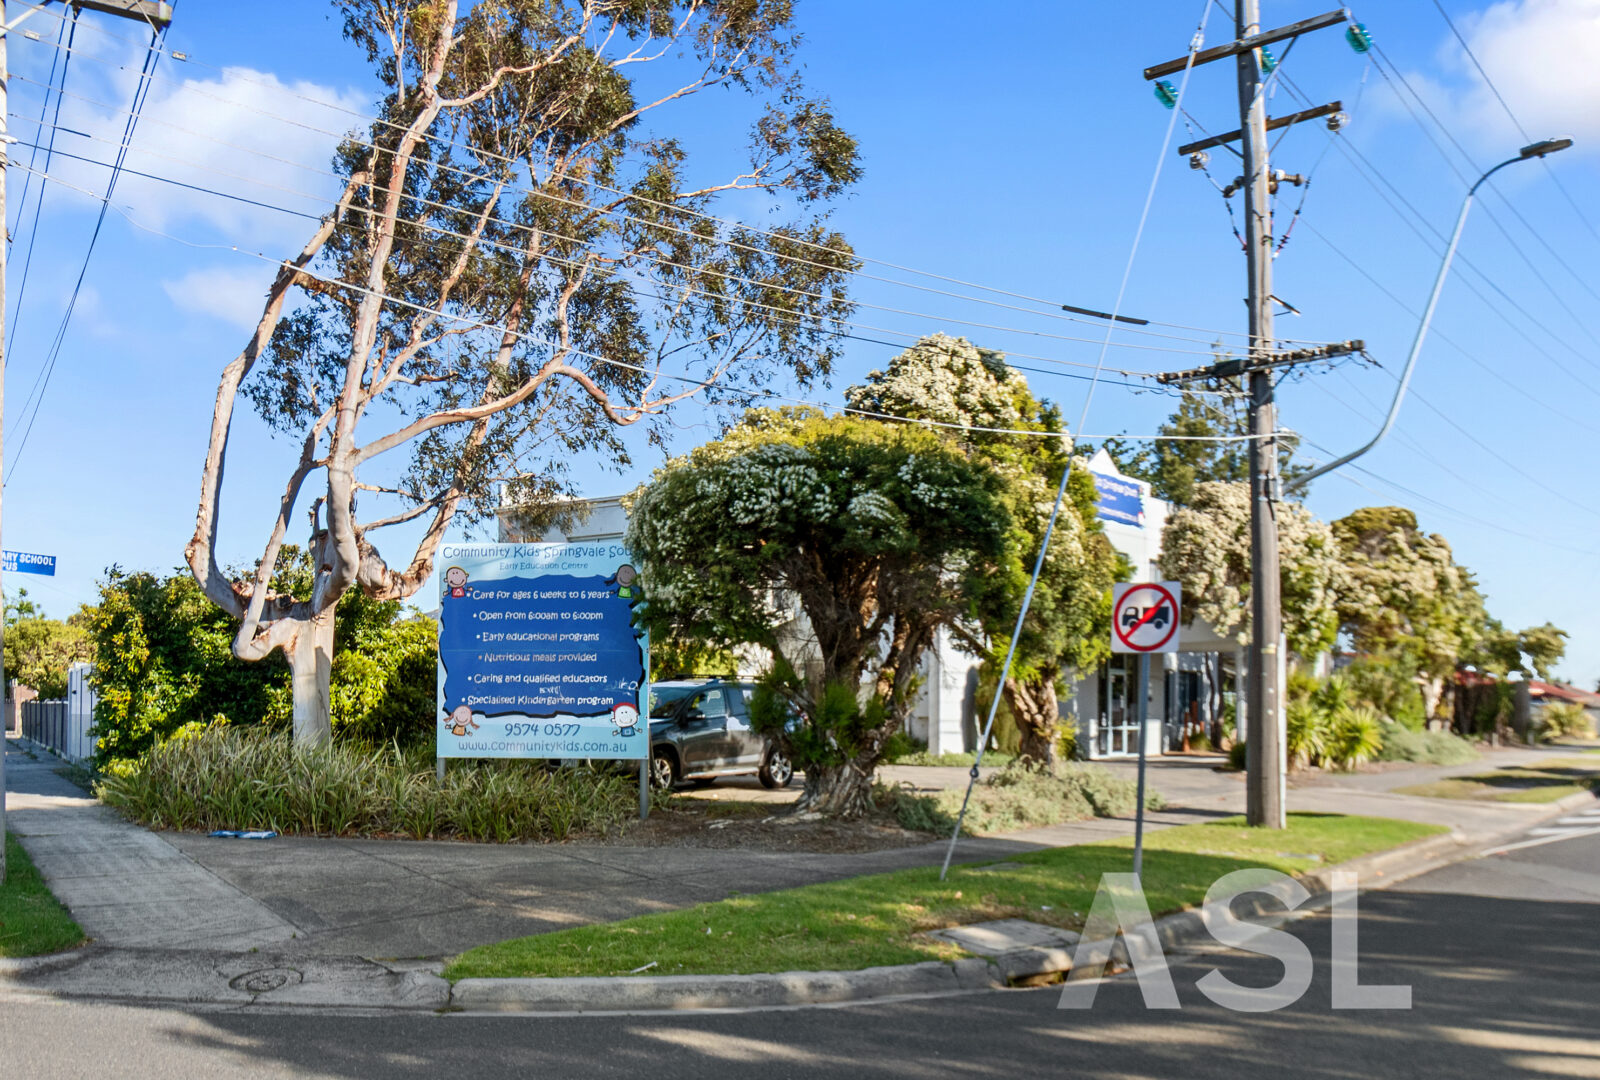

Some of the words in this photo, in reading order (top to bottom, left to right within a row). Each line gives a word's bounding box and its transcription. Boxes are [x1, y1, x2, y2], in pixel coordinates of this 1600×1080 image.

[443, 546, 510, 559] Community
[513, 546, 540, 558] Kids
[544, 546, 606, 559] Springvale
[19, 554, 54, 566] SCHOOL
[500, 562, 519, 571] Early
[520, 561, 559, 571] Education
[561, 562, 589, 570] Centre
[472, 590, 495, 600] Care
[496, 590, 511, 600] for
[512, 591, 532, 600] ages
[533, 590, 539, 600] 6
[540, 590, 567, 599] weeks
[568, 591, 579, 599] to
[580, 590, 586, 599] 6
[587, 591, 610, 599] years
[478, 611, 503, 621] Open
[504, 611, 527, 620] from
[528, 611, 559, 620] 6:00am
[560, 612, 571, 620] to
[572, 611, 604, 620] 6:00pm
[482, 632, 505, 642] Early
[506, 632, 558, 641] educational
[559, 633, 600, 642] programs
[484, 652, 531, 663] Nutritious
[532, 653, 557, 662] meals
[558, 652, 598, 662] provided
[473, 673, 503, 684] Caring
[504, 673, 522, 683] and
[523, 673, 561, 684] qualified
[562, 673, 608, 683] educators
[467, 695, 516, 705] Specialised
[517, 695, 576, 706] Kindergarten
[577, 696, 614, 706] program
[504, 723, 540, 737] 9574
[544, 723, 581, 736] 0577
[458, 740, 628, 753] www.communitykids.com.au
